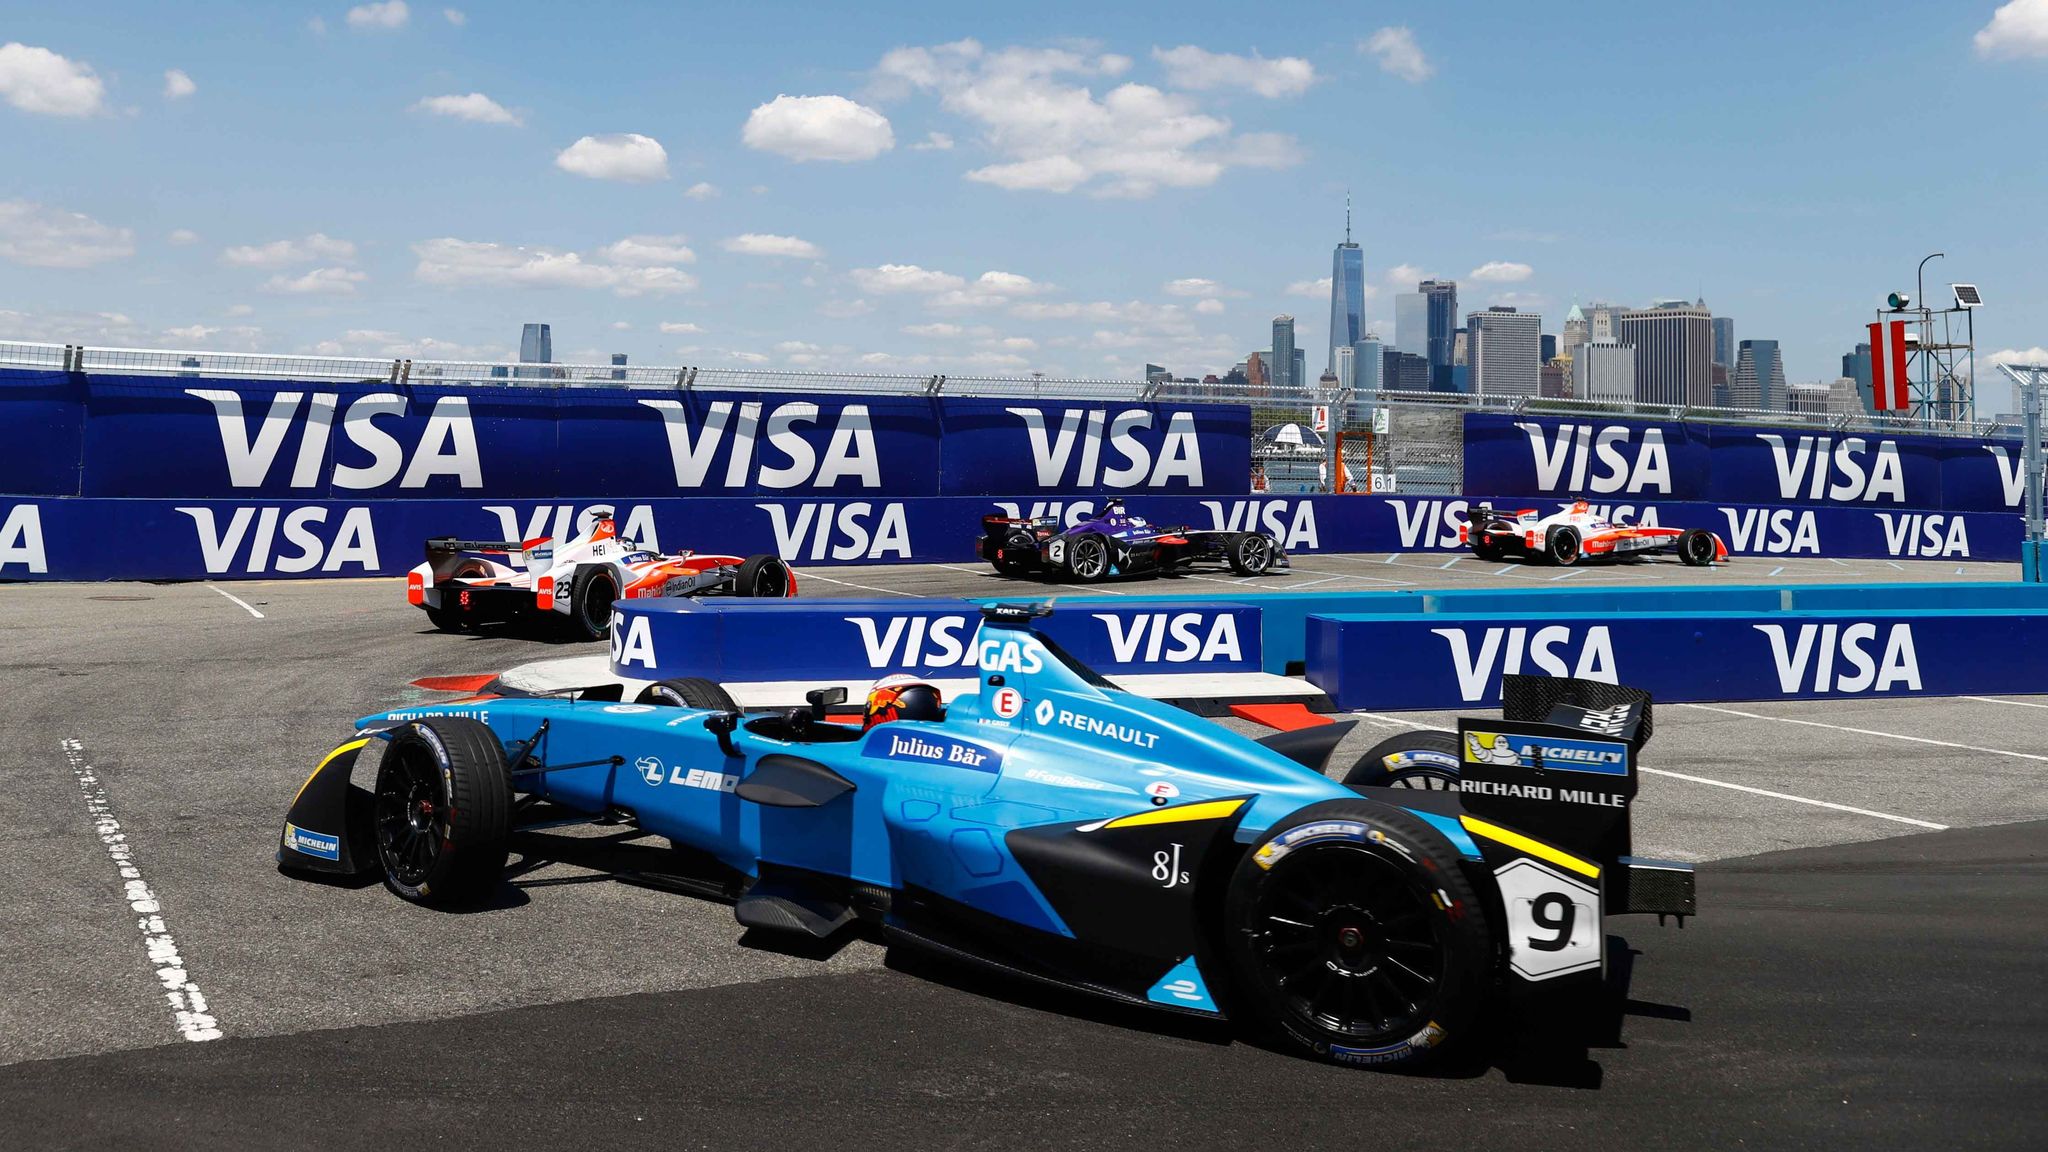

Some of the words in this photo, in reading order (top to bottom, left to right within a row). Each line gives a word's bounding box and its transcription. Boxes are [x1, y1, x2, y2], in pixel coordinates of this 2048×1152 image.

[185, 389, 483, 489] VISA
[638, 400, 881, 488] VISA
[1006, 408, 1203, 488] VISA
[1514, 422, 1671, 493] VISA
[1374, 477, 1392, 490] 6.1
[1756, 434, 1905, 502] VISA
[175, 506, 380, 573] VISA
[755, 502, 912, 561] VISA
[1199, 500, 1318, 551] VISA
[1718, 508, 1820, 553] VISA
[1874, 513, 1969, 557] VISA
[592, 545, 606, 556] HEI
[1053, 545, 1061, 557] 2
[555, 582, 571, 599] 23
[610, 609, 657, 669] SA
[979, 640, 1043, 674] GAS
[1092, 613, 1242, 662] VISA
[1753, 623, 1922, 693] VISA
[1431, 626, 1619, 701] VISA
[1001, 693, 1012, 713] E
[889, 736, 943, 759] Julius
[948, 745, 987, 767] Bär
[1058, 710, 1160, 748] RENAULT
[669, 766, 740, 794] LEMO
[1461, 780, 1552, 800] RICHARD
[1560, 789, 1625, 808] MILLE
[298, 835, 337, 852] MICHELIN
[1152, 843, 1190, 889] 8Js
[1529, 891, 1576, 952] 9
